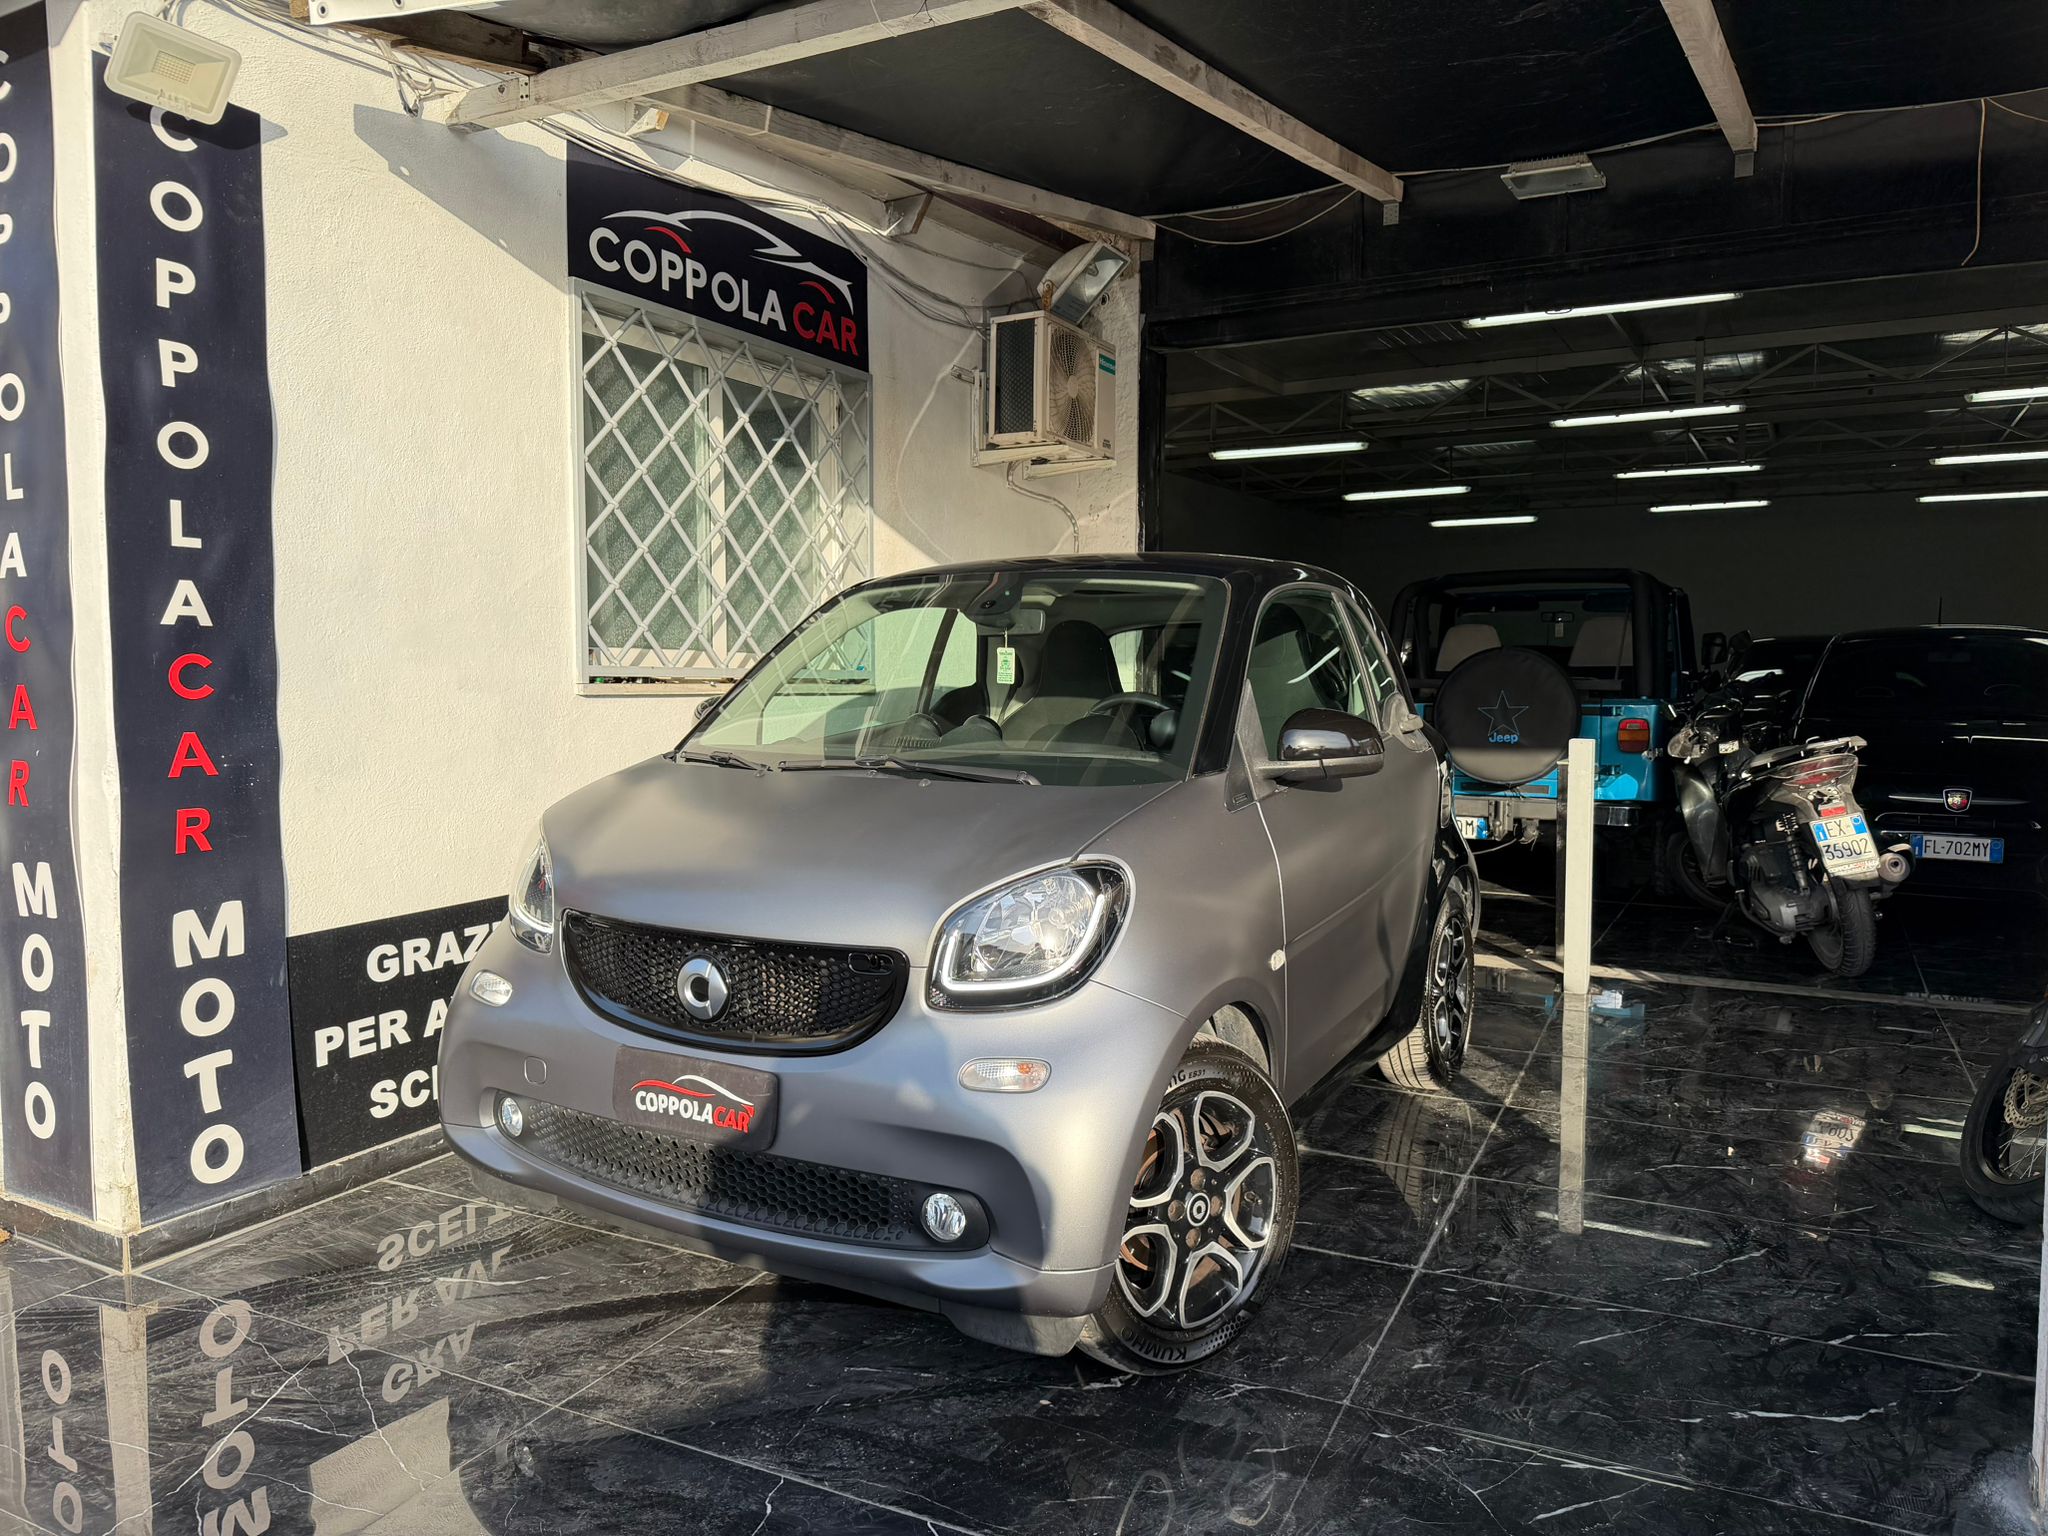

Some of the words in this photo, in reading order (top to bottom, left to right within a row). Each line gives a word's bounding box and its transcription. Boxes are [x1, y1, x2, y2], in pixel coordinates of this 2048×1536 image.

[1488, 732, 1519, 744] Jeep
[1823, 838, 1872, 861] 35902
[367, 921, 501, 983] GRAZ
[12, 862, 58, 1139] MOTO
[172, 900, 245, 1184] MOTO
[315, 1009, 411, 1068] PER
[1121, 1327, 1187, 1361] KUMHO
